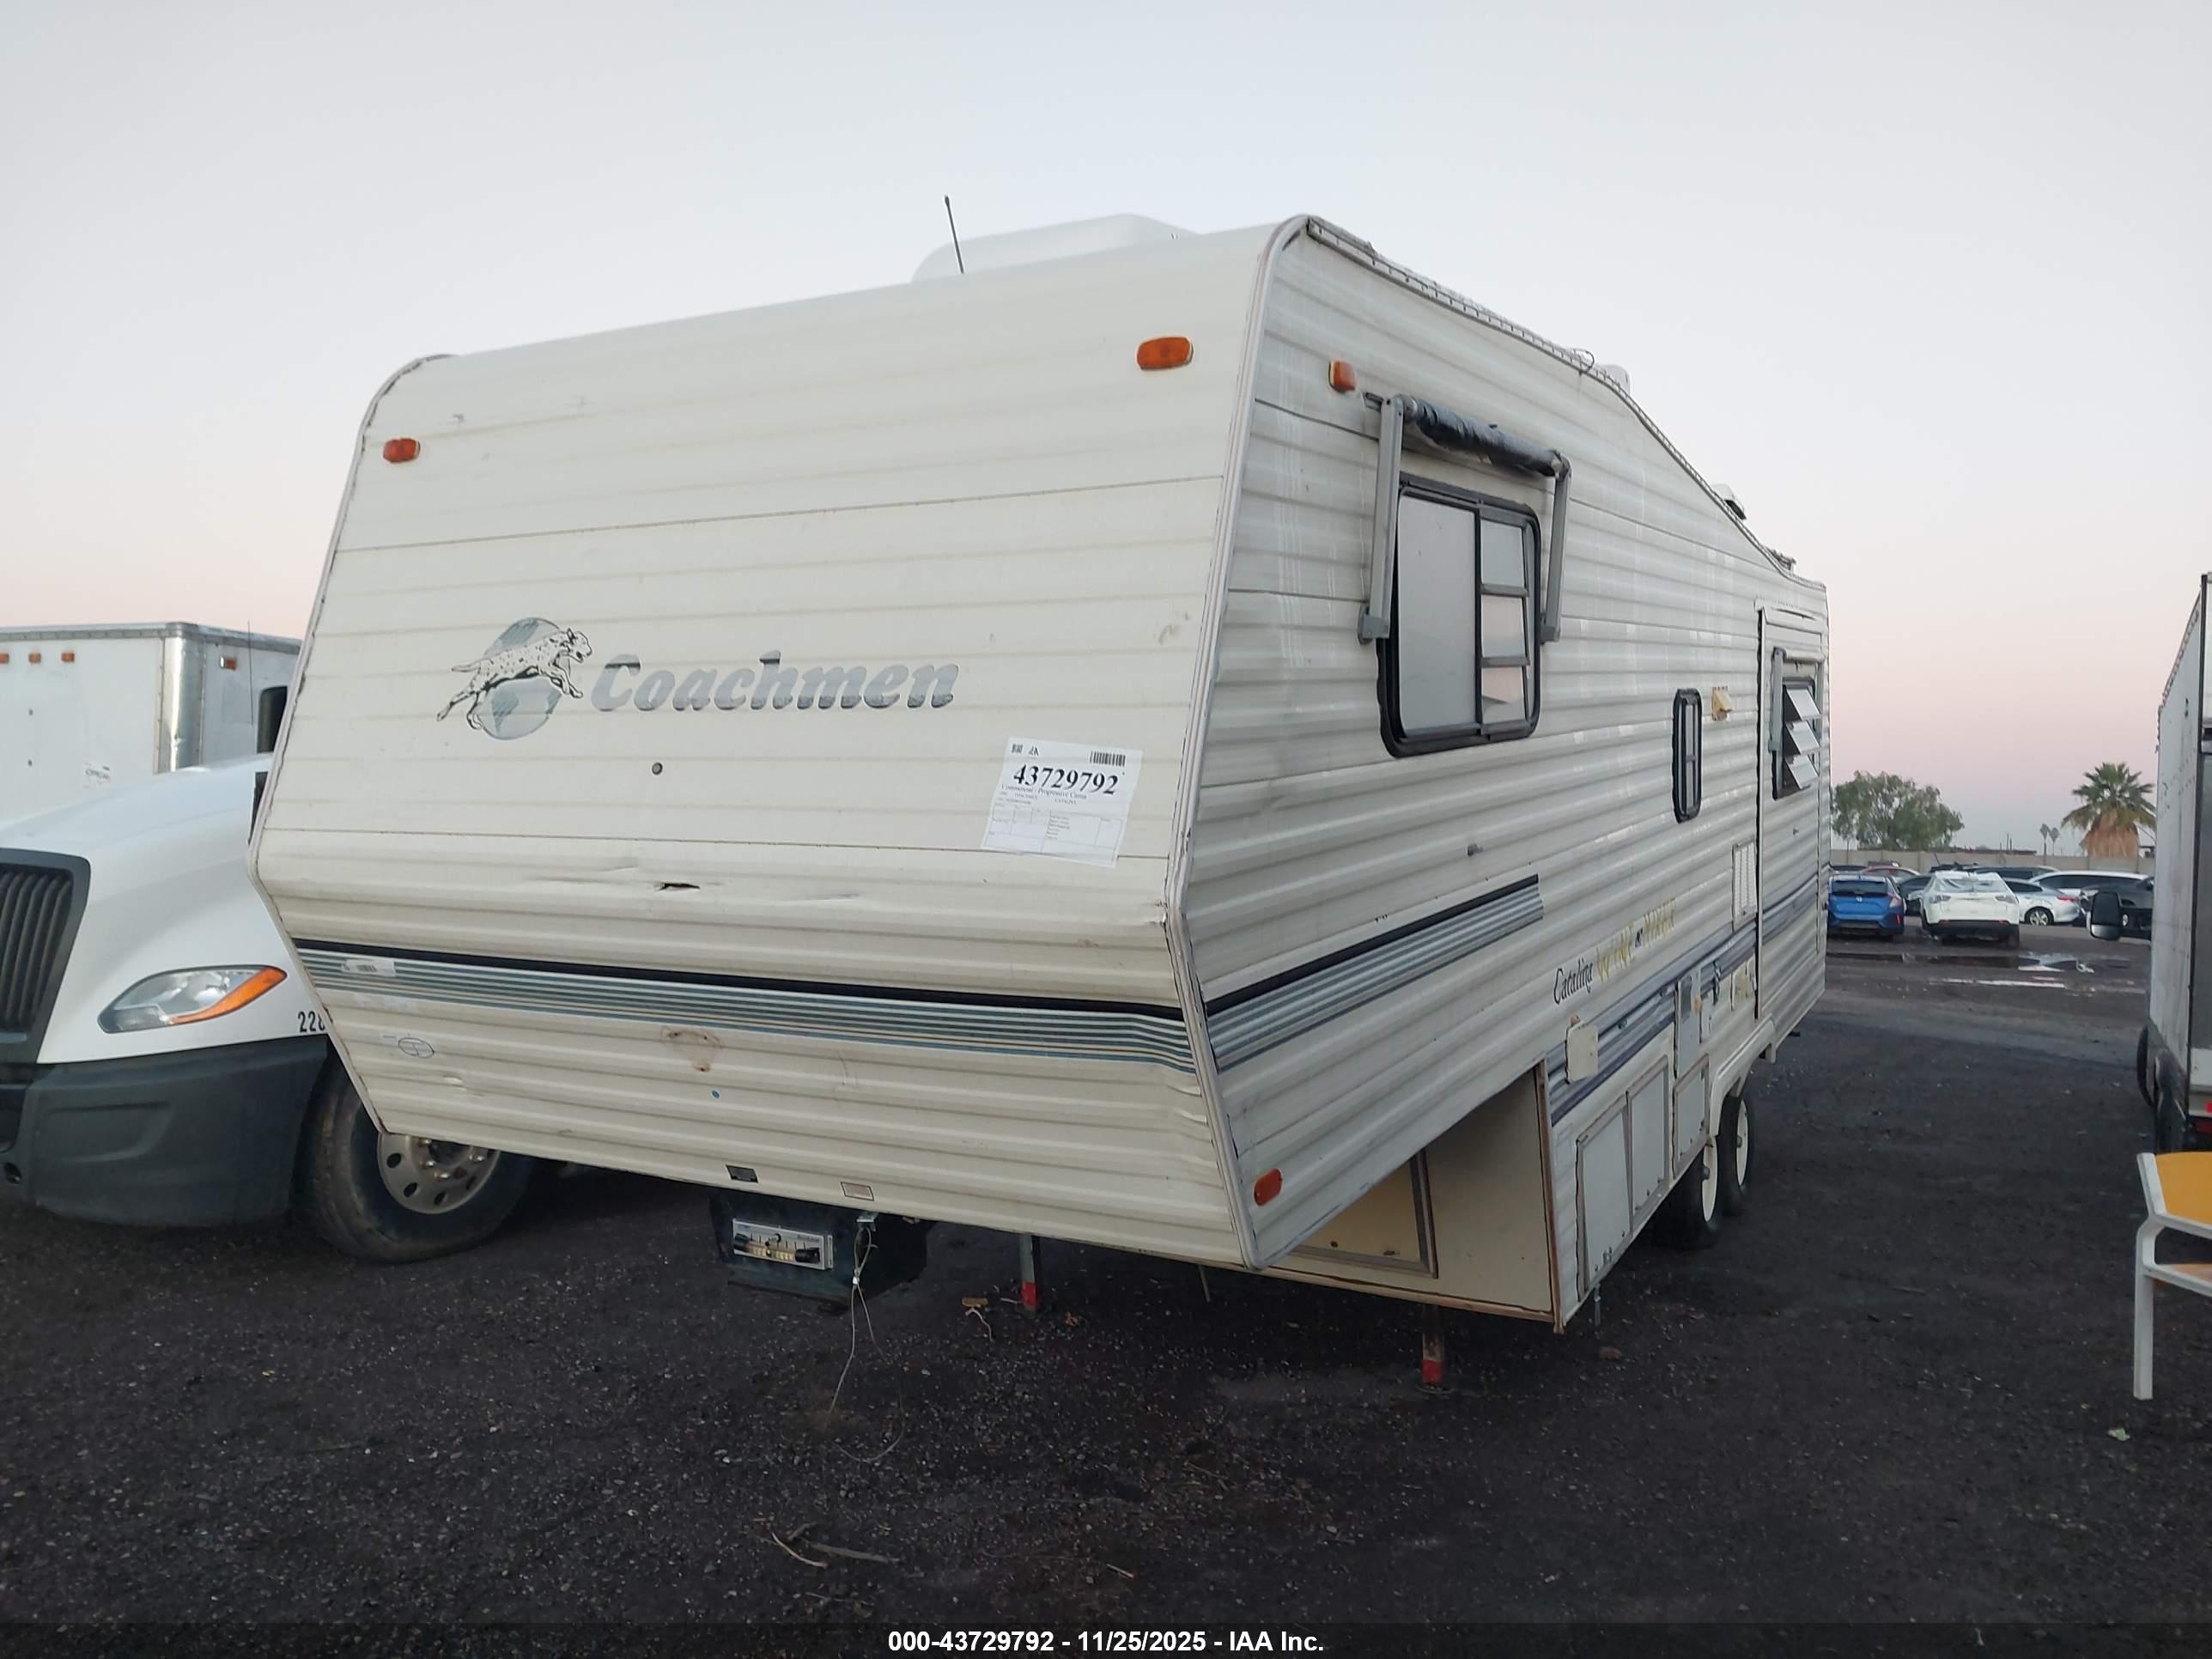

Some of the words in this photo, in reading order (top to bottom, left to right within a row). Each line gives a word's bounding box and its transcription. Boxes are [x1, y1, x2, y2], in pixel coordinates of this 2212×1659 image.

[591, 649, 960, 712] Coachmen
[1013, 763, 1119, 795] 43729792
[1553, 957, 1594, 1005] Catalina
